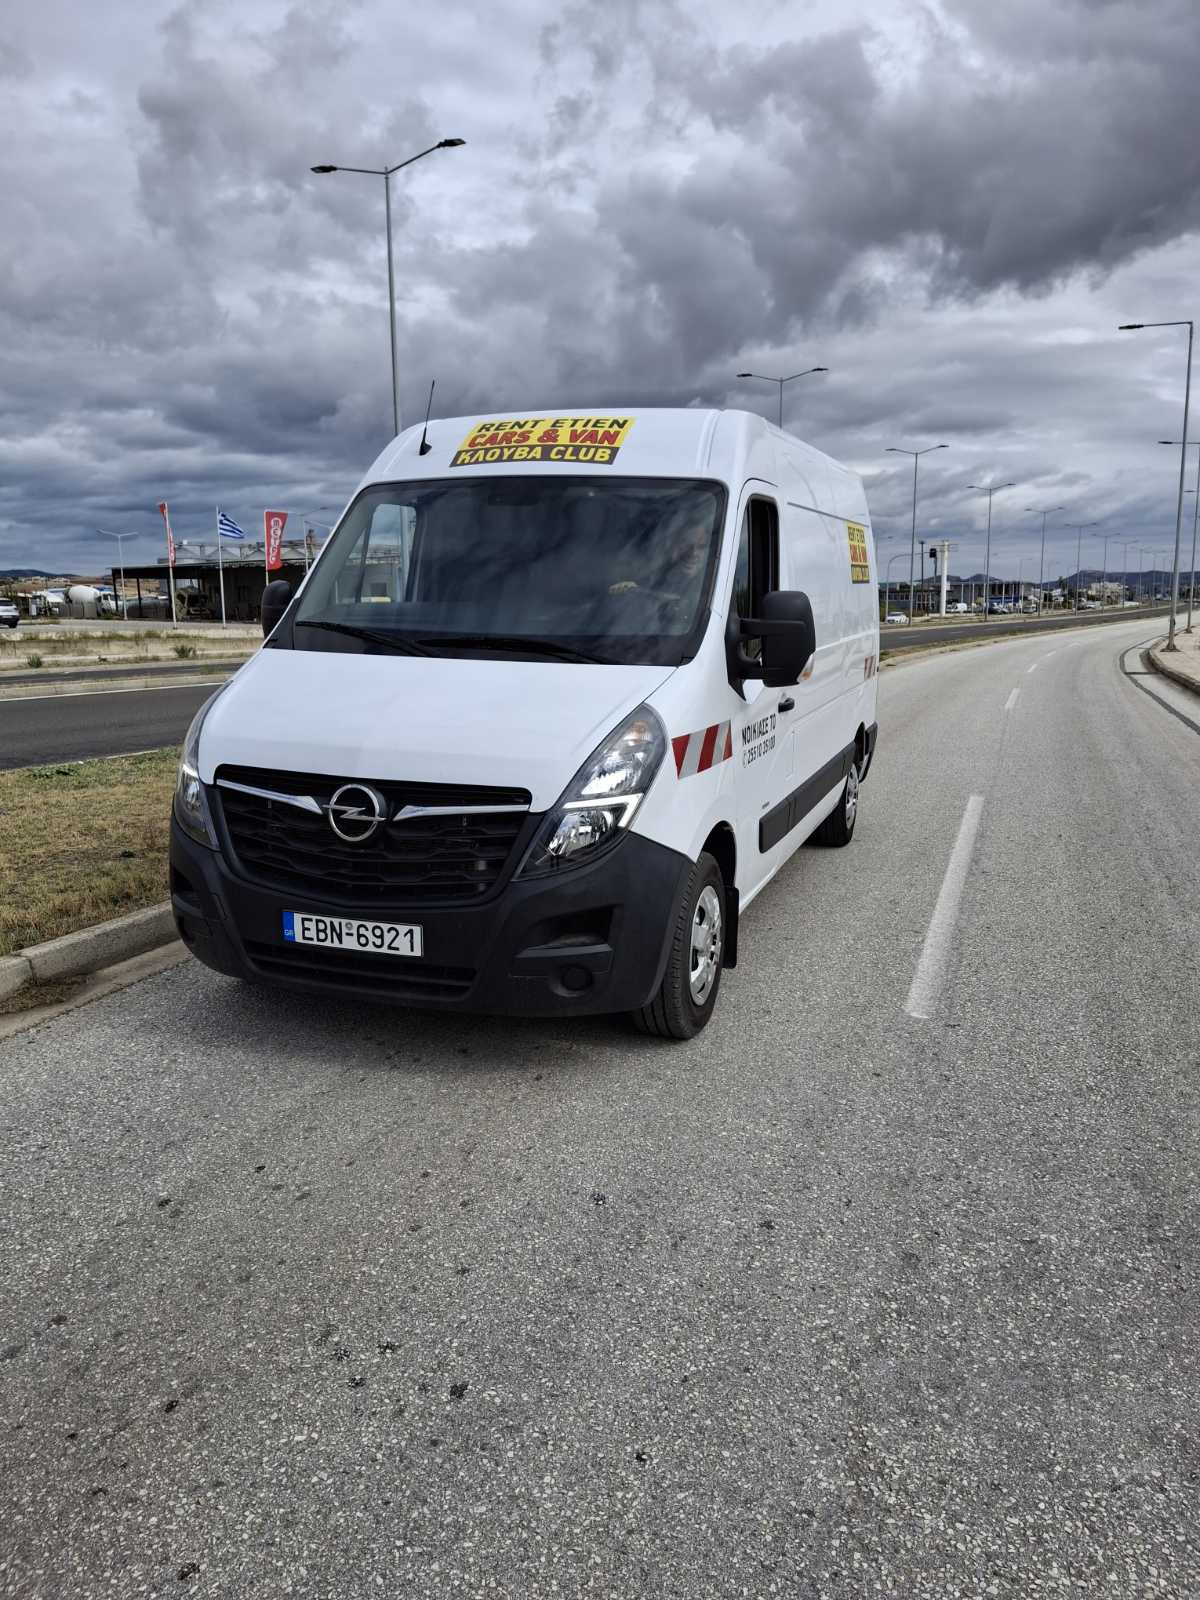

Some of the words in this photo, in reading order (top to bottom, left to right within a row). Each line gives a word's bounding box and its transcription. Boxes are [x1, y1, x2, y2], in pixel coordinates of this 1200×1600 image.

[477, 419, 545, 433] RENT
[550, 418, 629, 429] ETIEN
[467, 429, 535, 449] CARS
[537, 428, 560, 443] &
[568, 429, 622, 445] VAN
[550, 446, 611, 461] CLUB
